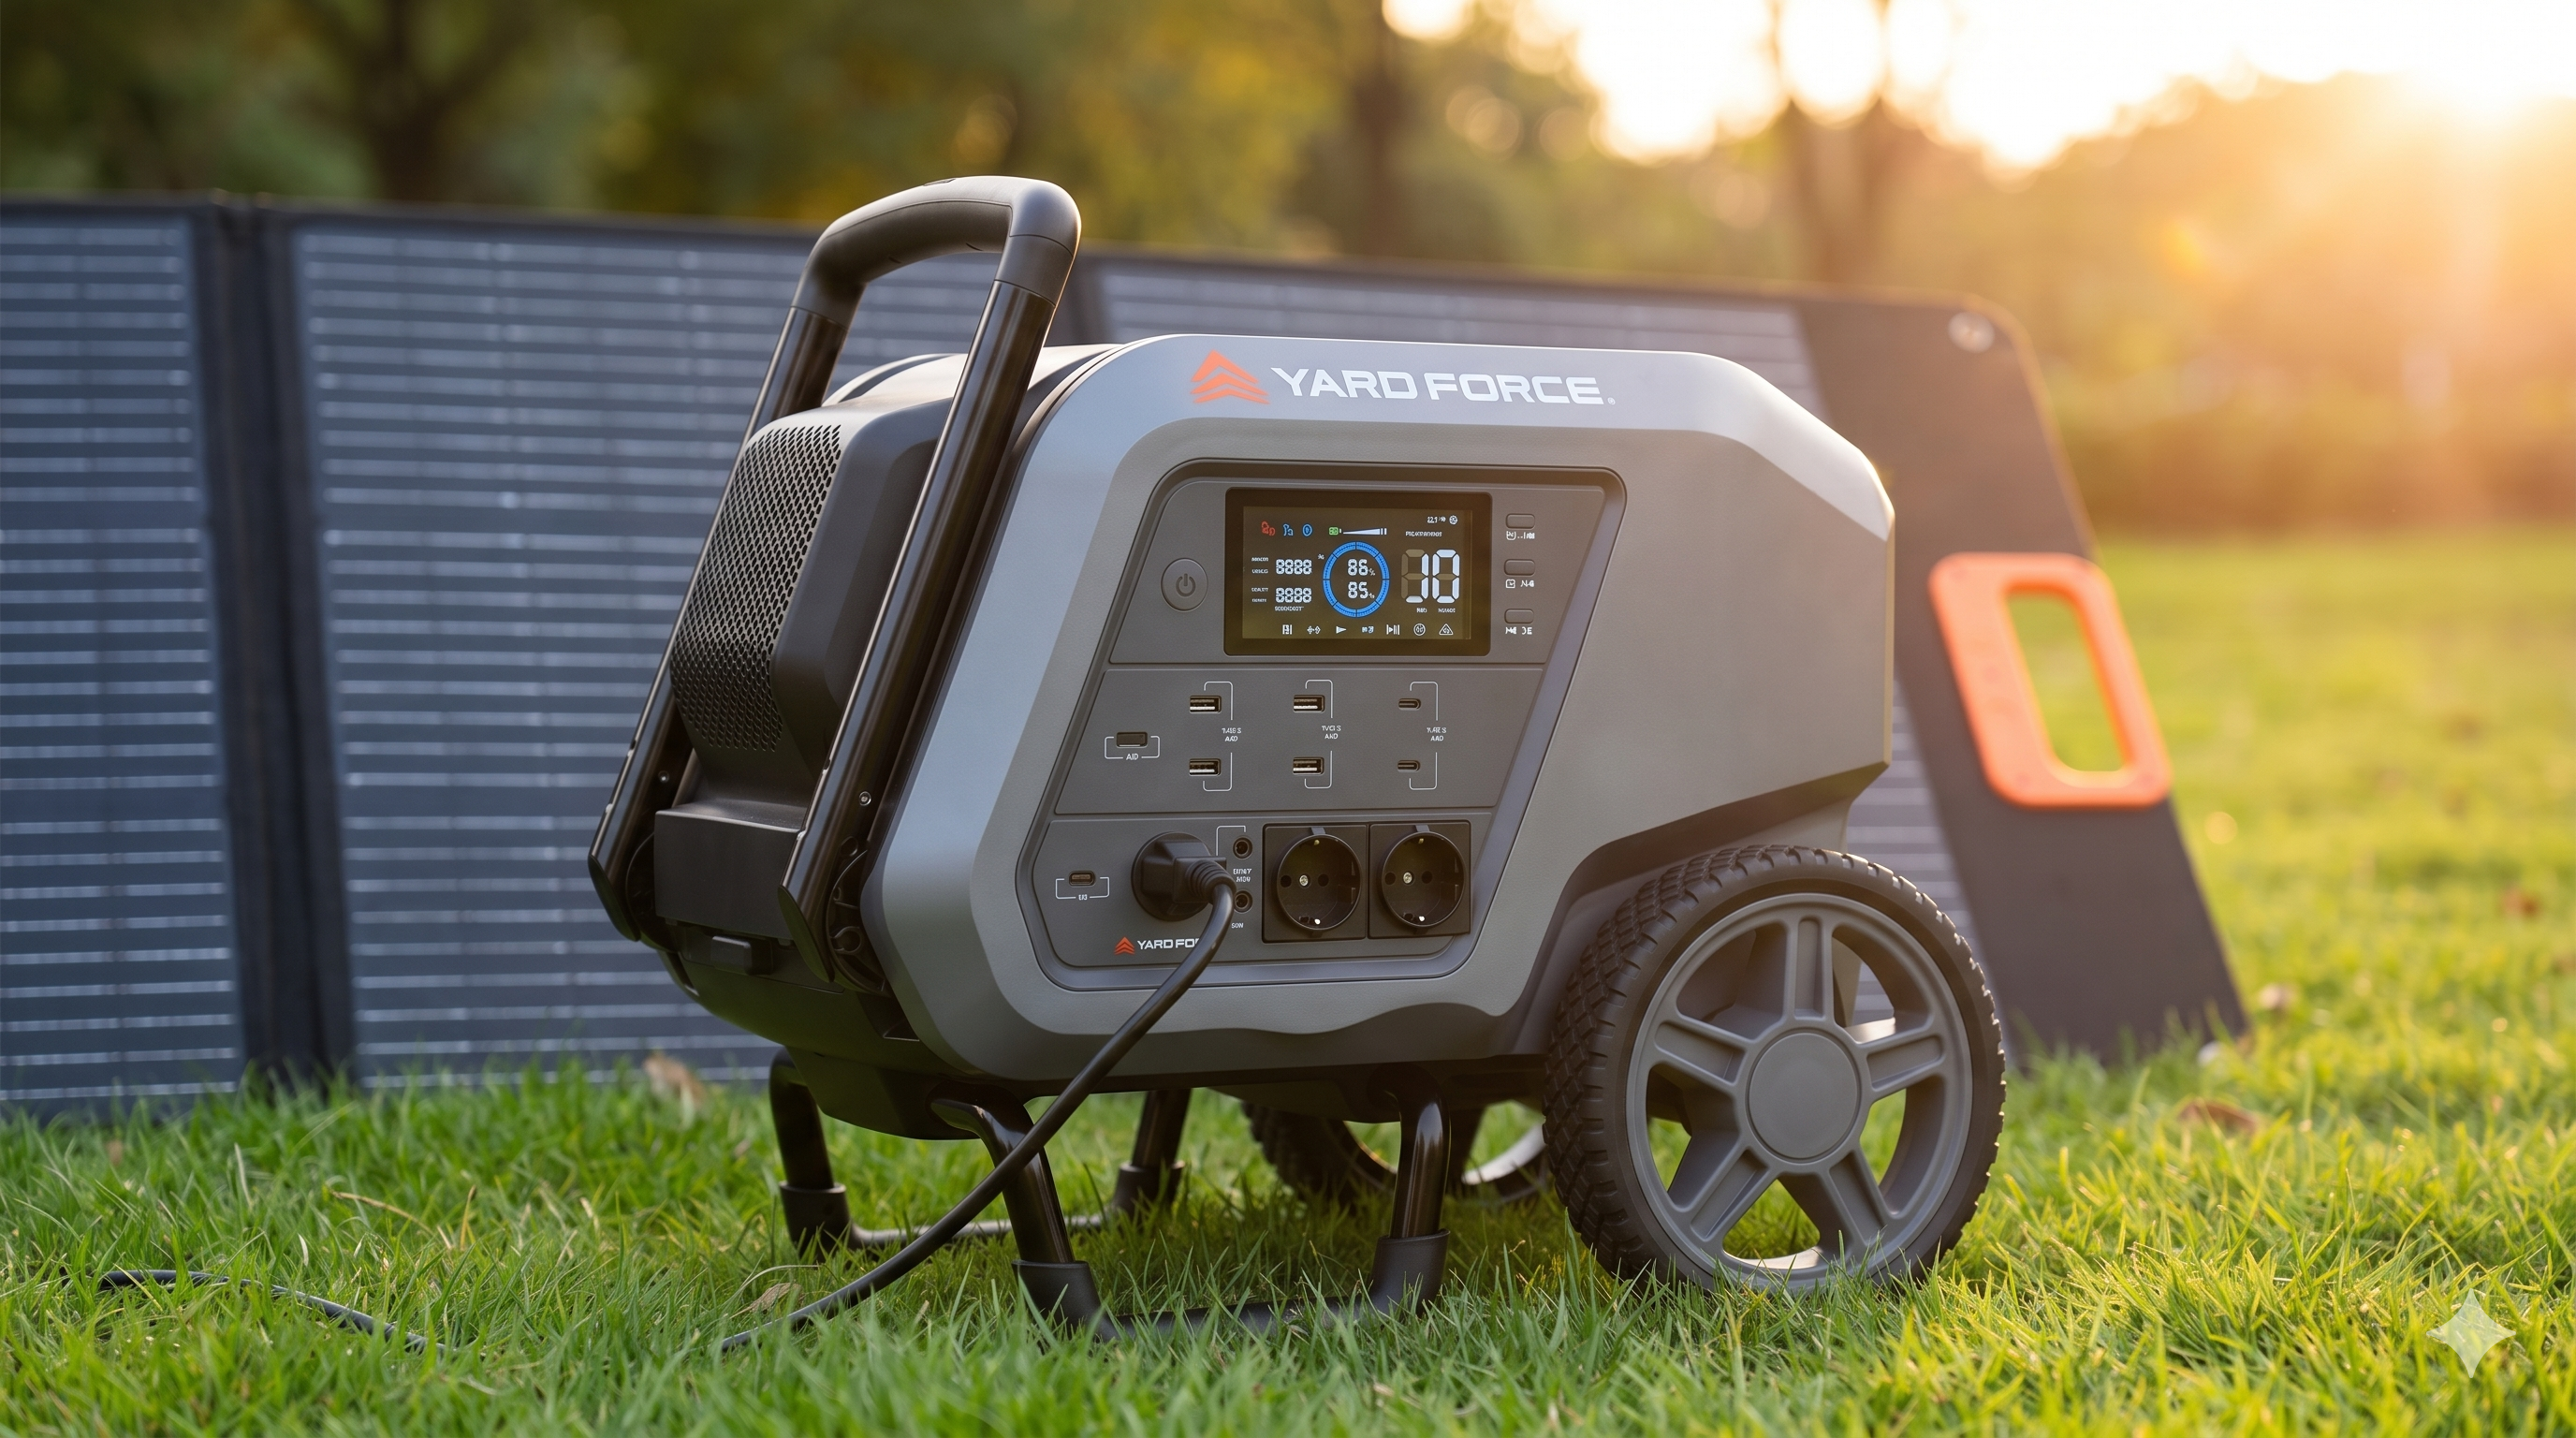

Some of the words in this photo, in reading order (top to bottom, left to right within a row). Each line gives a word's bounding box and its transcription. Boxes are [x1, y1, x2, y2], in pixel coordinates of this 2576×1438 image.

[1270, 367, 1419, 400] YARD
[1423, 372, 1604, 405] FORCE
[1136, 939, 1174, 950] YARD
